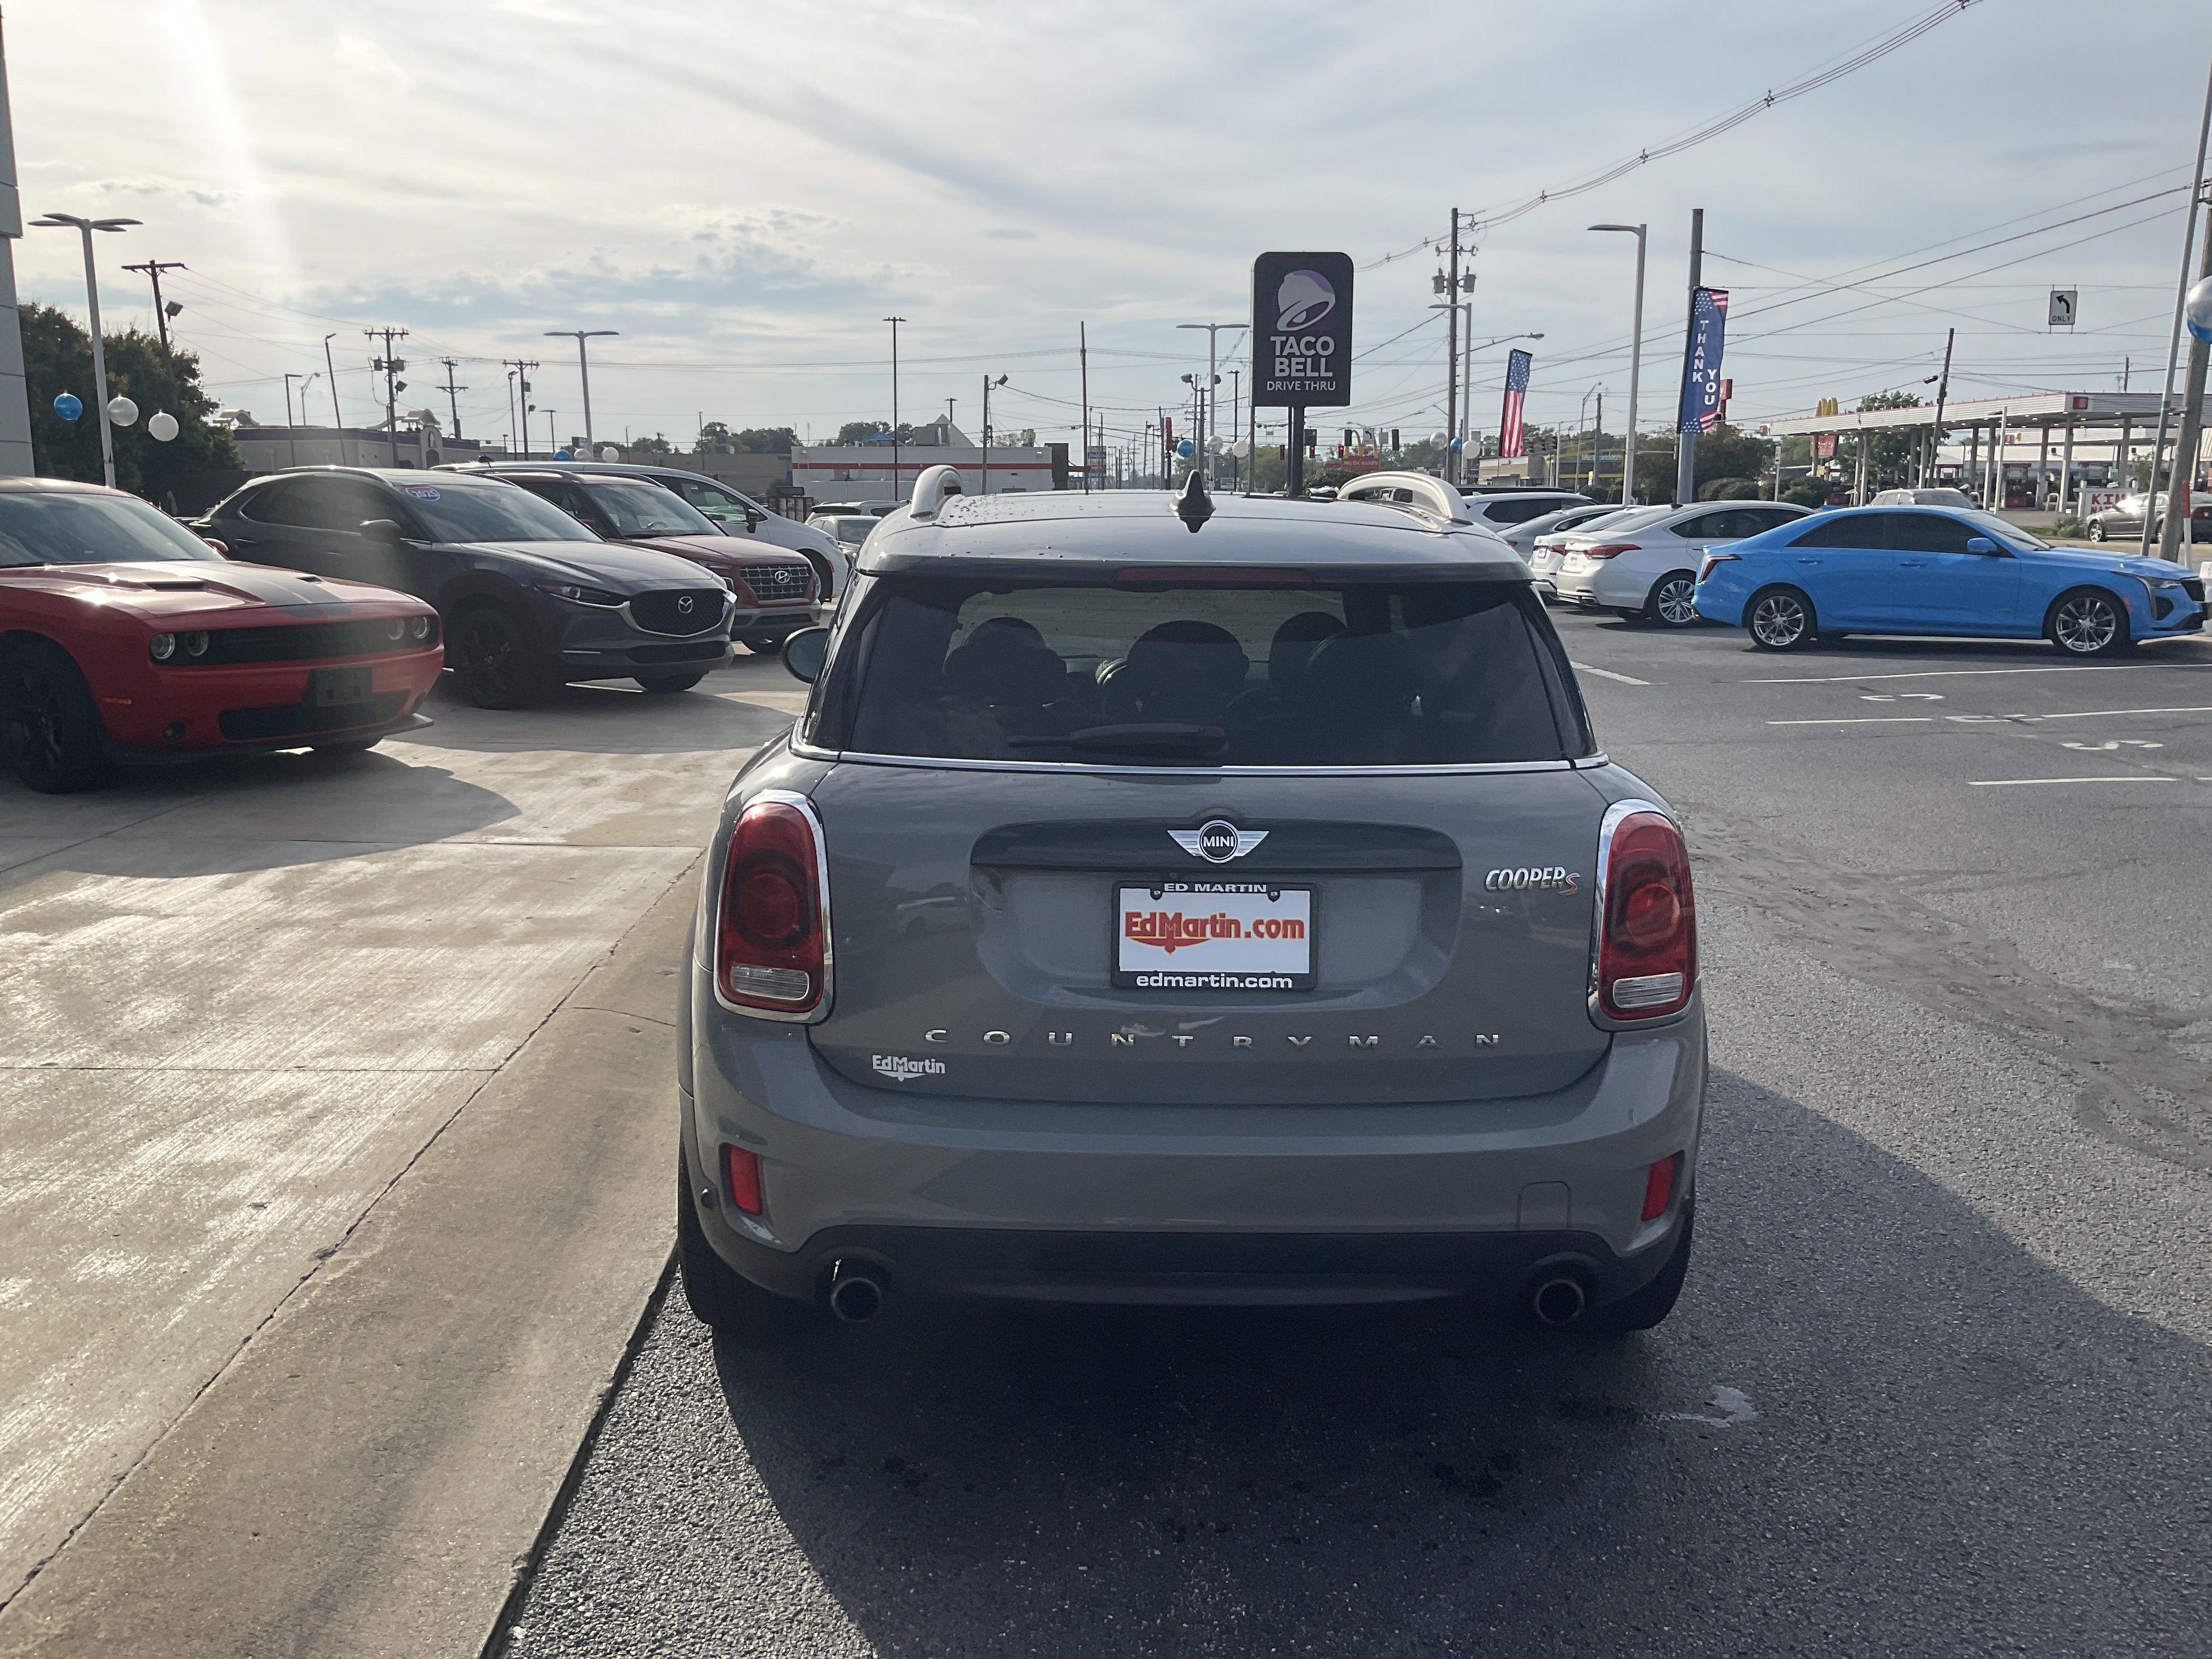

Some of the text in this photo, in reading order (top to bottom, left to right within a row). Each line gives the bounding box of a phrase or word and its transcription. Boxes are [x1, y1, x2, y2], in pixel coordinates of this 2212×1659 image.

[1270, 336, 1335, 356] TACO
[1274, 357, 1333, 377] BELL
[1692, 320, 1717, 406] THANK YOU
[1267, 381, 1336, 391] DRIVE THRU
[1203, 836, 1234, 847] MINI
[1164, 883, 1267, 893] ED MARTIN
[1485, 866, 1566, 891] COOPER
[1125, 911, 1304, 940] EdMartin.com
[1136, 973, 1293, 988] edmartin.com
[925, 1029, 1500, 1049] COUNTRYMAN
[872, 1054, 945, 1074] EdMartin
